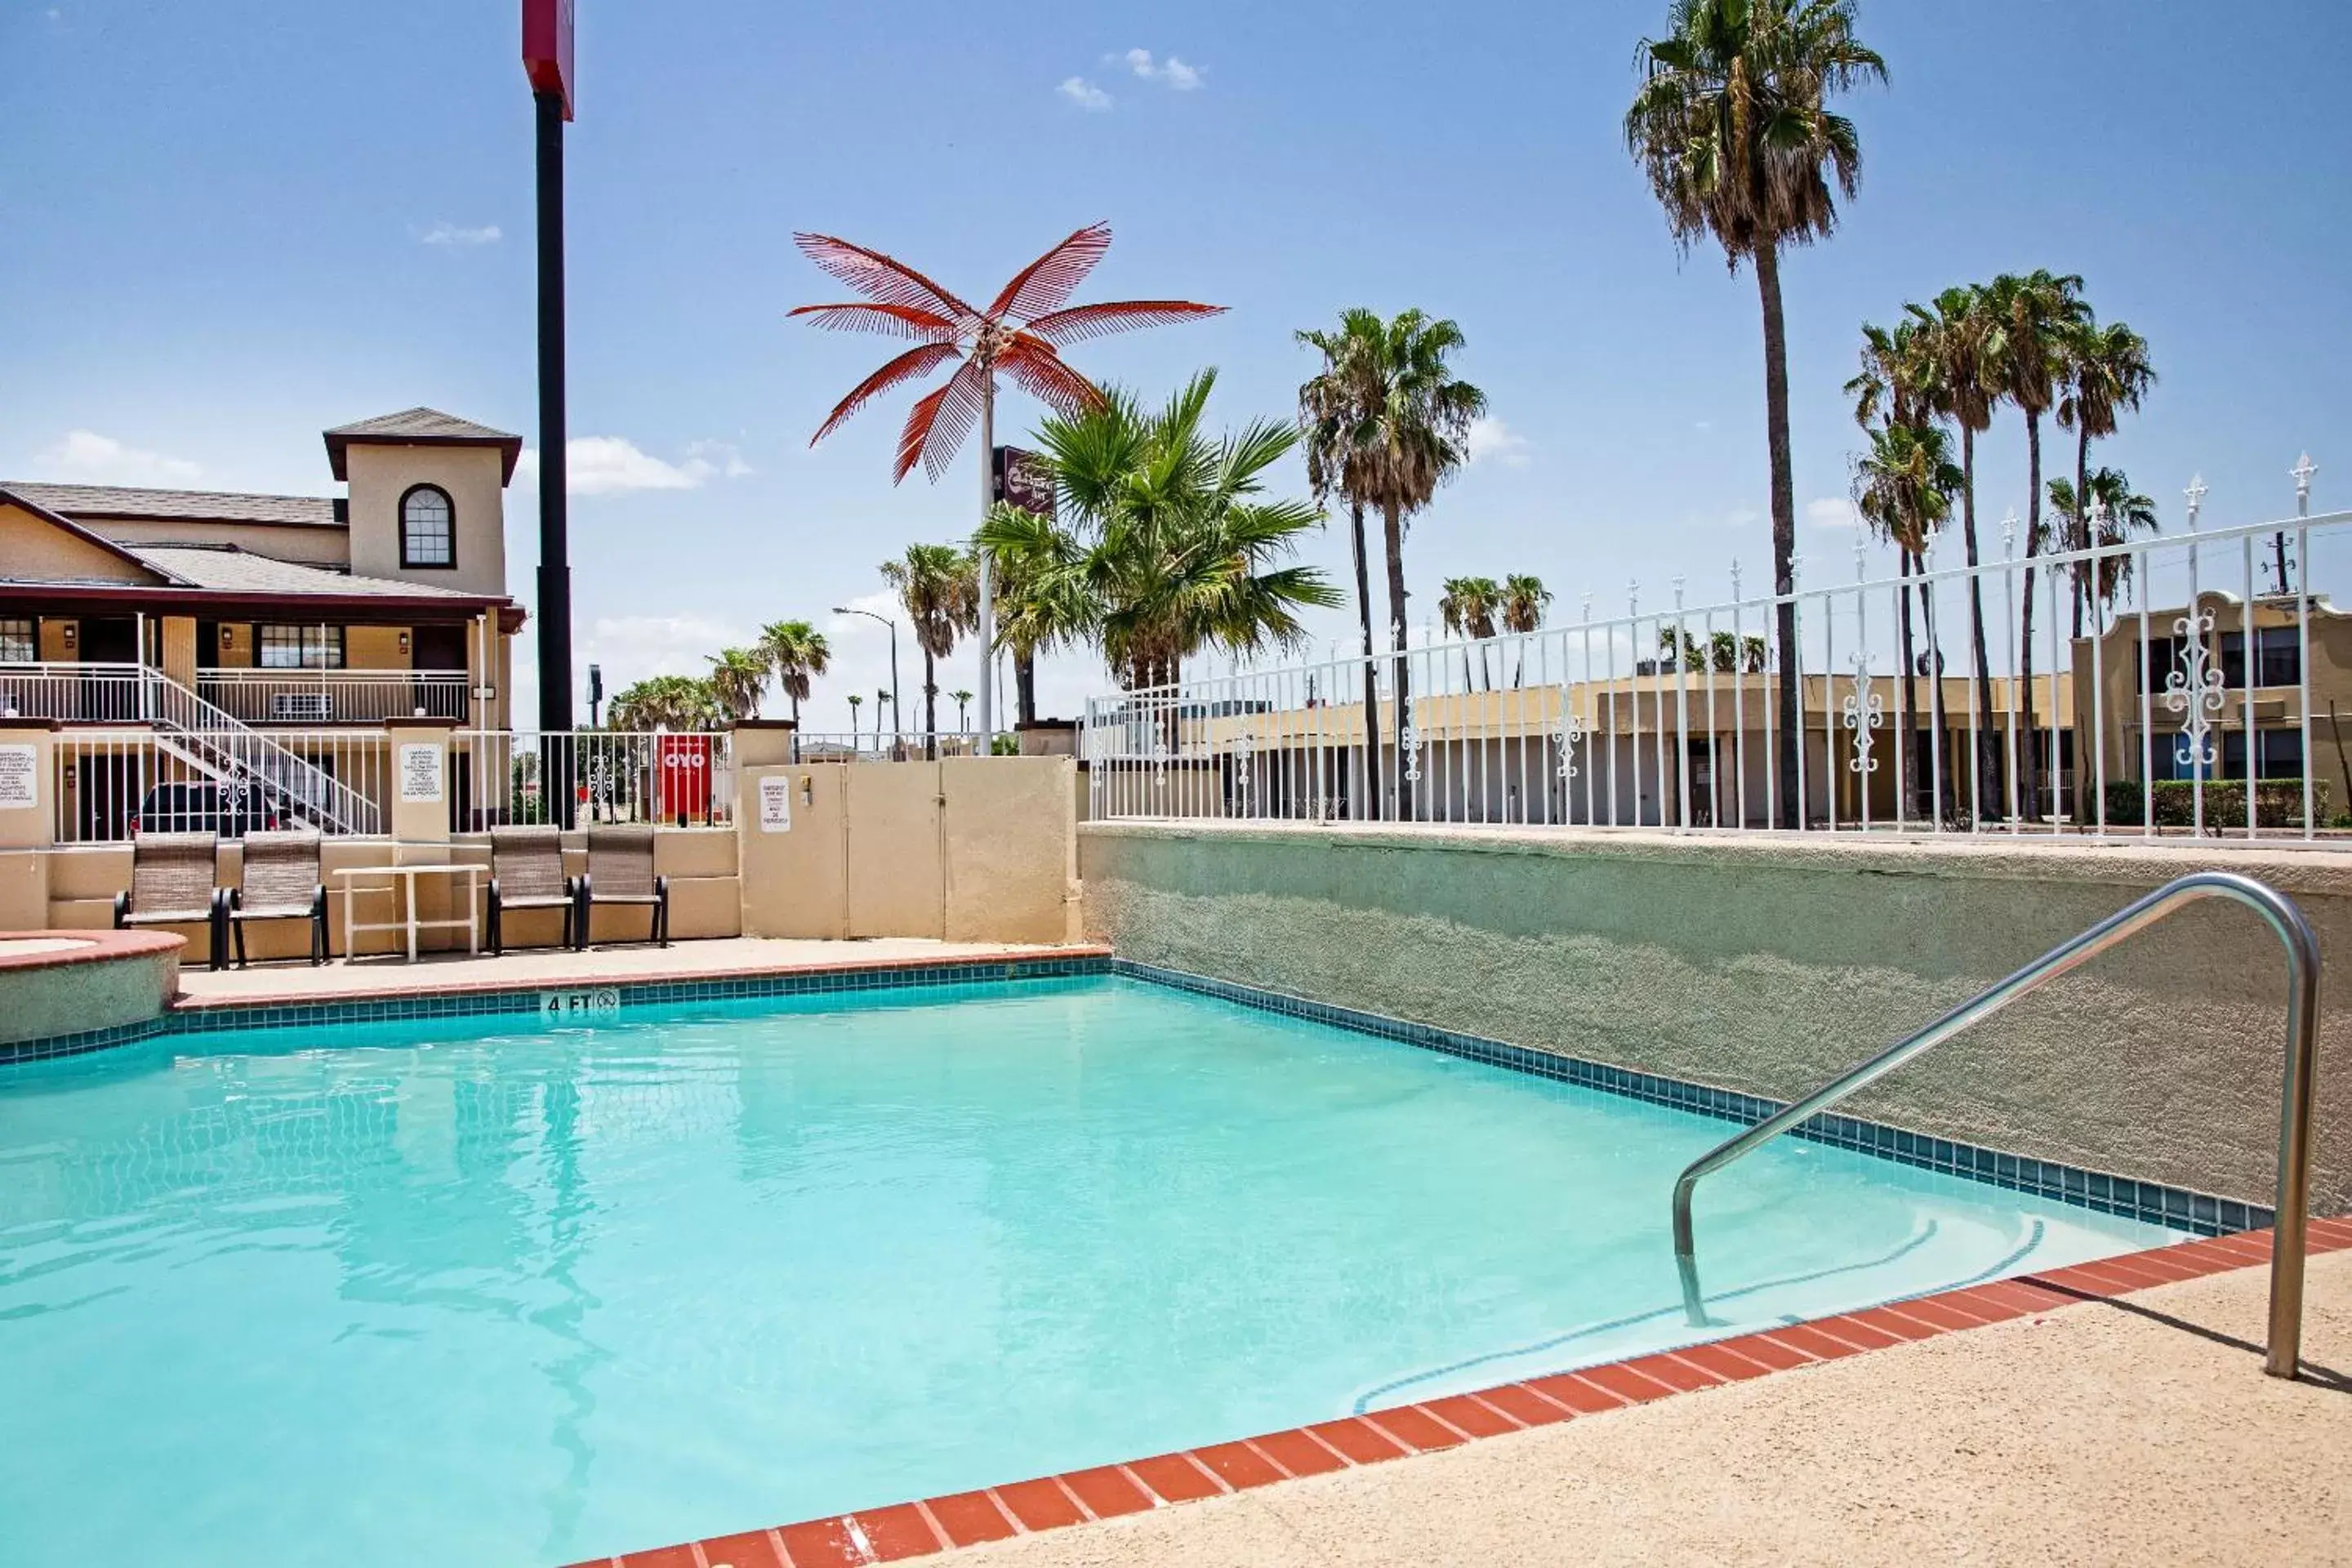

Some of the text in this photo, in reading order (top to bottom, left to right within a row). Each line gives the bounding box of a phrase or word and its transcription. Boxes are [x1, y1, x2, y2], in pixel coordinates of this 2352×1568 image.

[665, 754, 706, 768] OYO
[548, 994, 591, 1010] 4 FT
